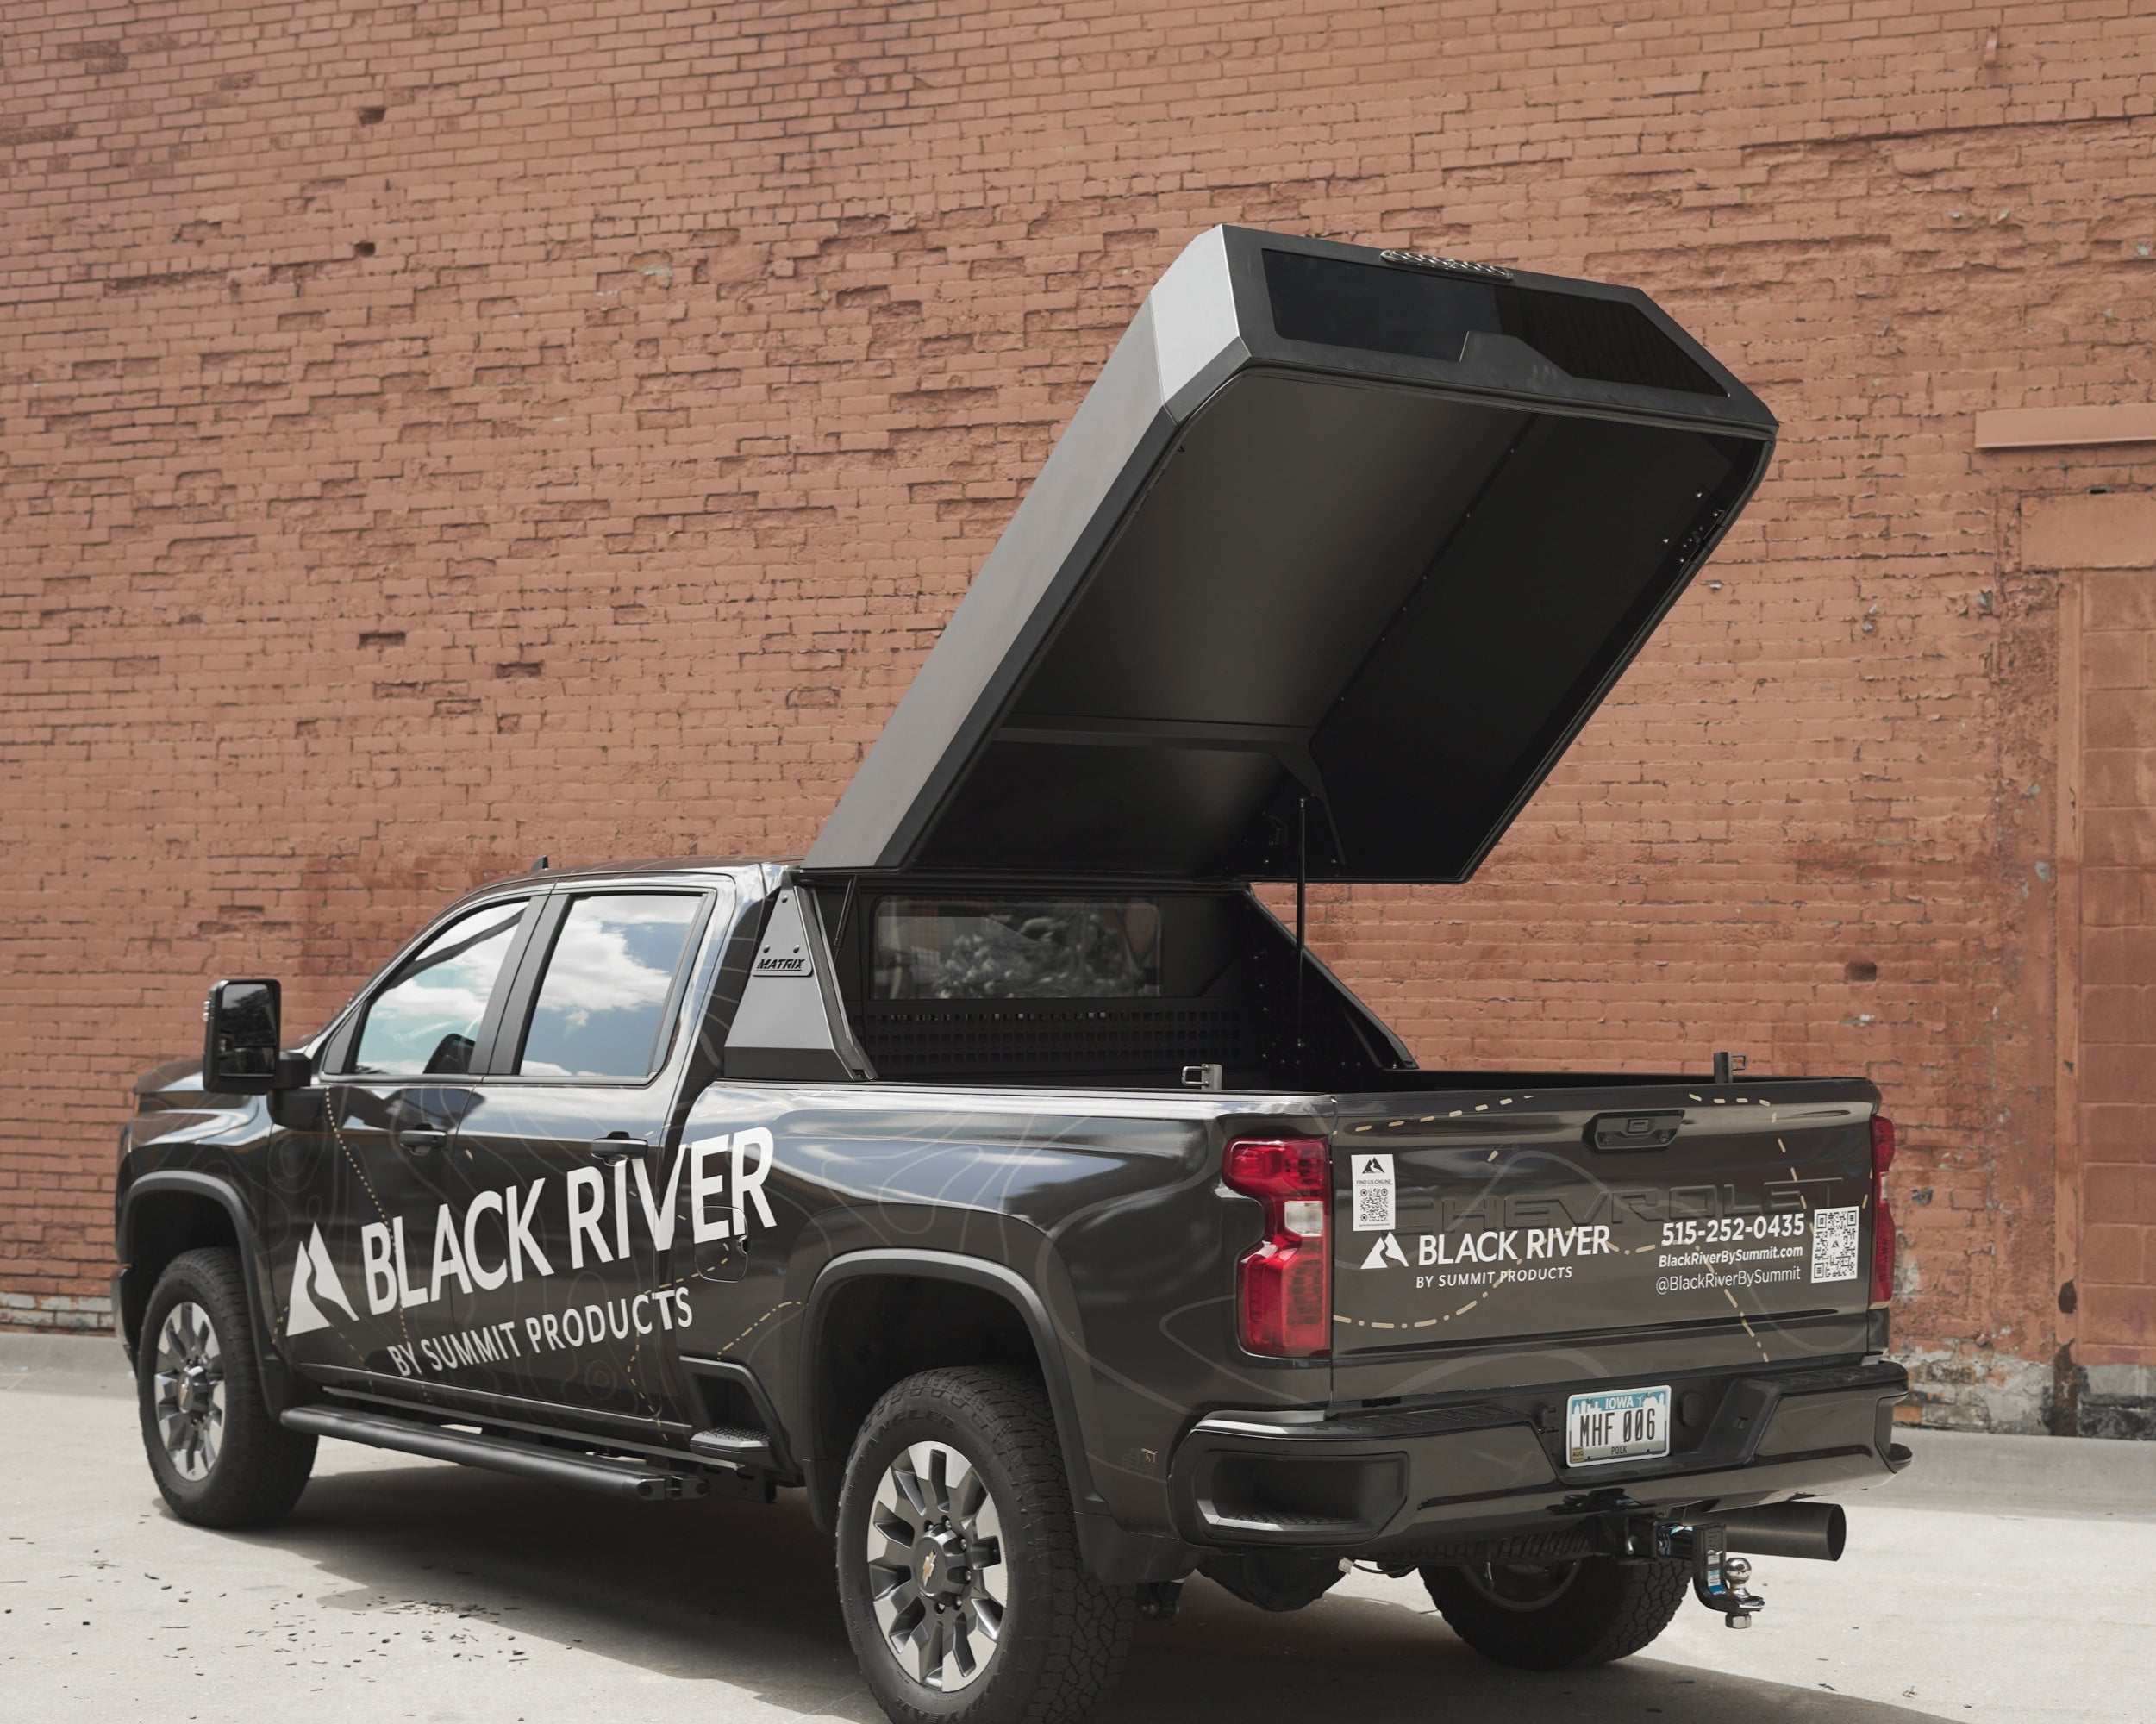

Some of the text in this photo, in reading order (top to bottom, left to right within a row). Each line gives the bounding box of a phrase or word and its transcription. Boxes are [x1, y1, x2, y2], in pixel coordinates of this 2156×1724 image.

[756, 959, 805, 969] MATRIX
[361, 1127, 776, 1315] BLACK RIVER
[1386, 1177, 1843, 1237] CHEVROLET
[1418, 1225, 1610, 1265] BLACK RIVER
[1661, 1213, 1805, 1246] 515-252-0435
[1659, 1246, 1803, 1268] BlackRiverBySummit.com
[1416, 1266, 1573, 1289] BY SUMMIT PRODUCTS
[1655, 1265, 1801, 1295] @BlackRiverBySummit
[387, 1287, 692, 1377] BY SUMMIT PRODUCTS
[1605, 1396, 1634, 1409] IOWA
[1580, 1408, 1655, 1447] MHF 006
[1611, 1446, 1628, 1455] POLK
